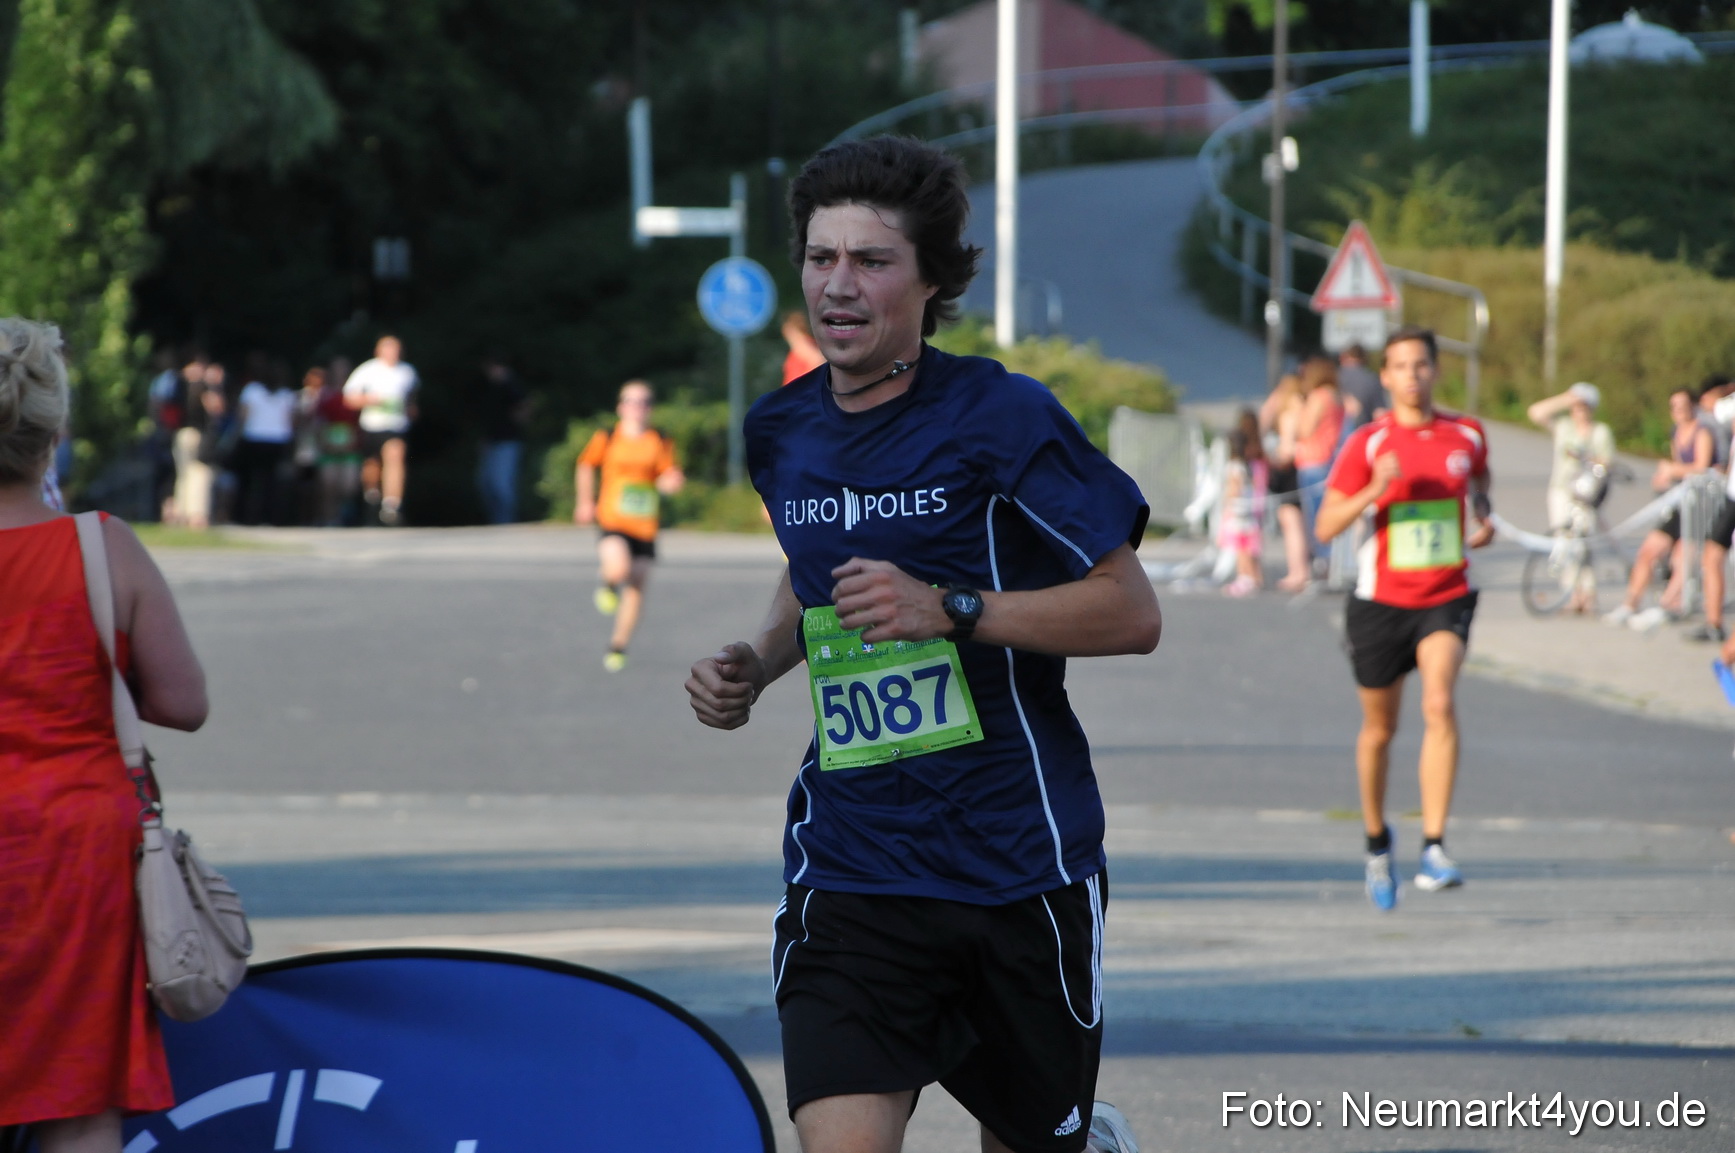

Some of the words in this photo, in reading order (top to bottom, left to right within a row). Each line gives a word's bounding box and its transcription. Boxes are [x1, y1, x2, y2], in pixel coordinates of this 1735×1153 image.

[785, 497, 839, 526] EURO
[864, 487, 948, 520] POLES
[1410, 522, 1444, 554] 12
[807, 614, 833, 632] 2014
[821, 662, 952, 745] 5087
[1054, 1119, 1082, 1137] adidas
